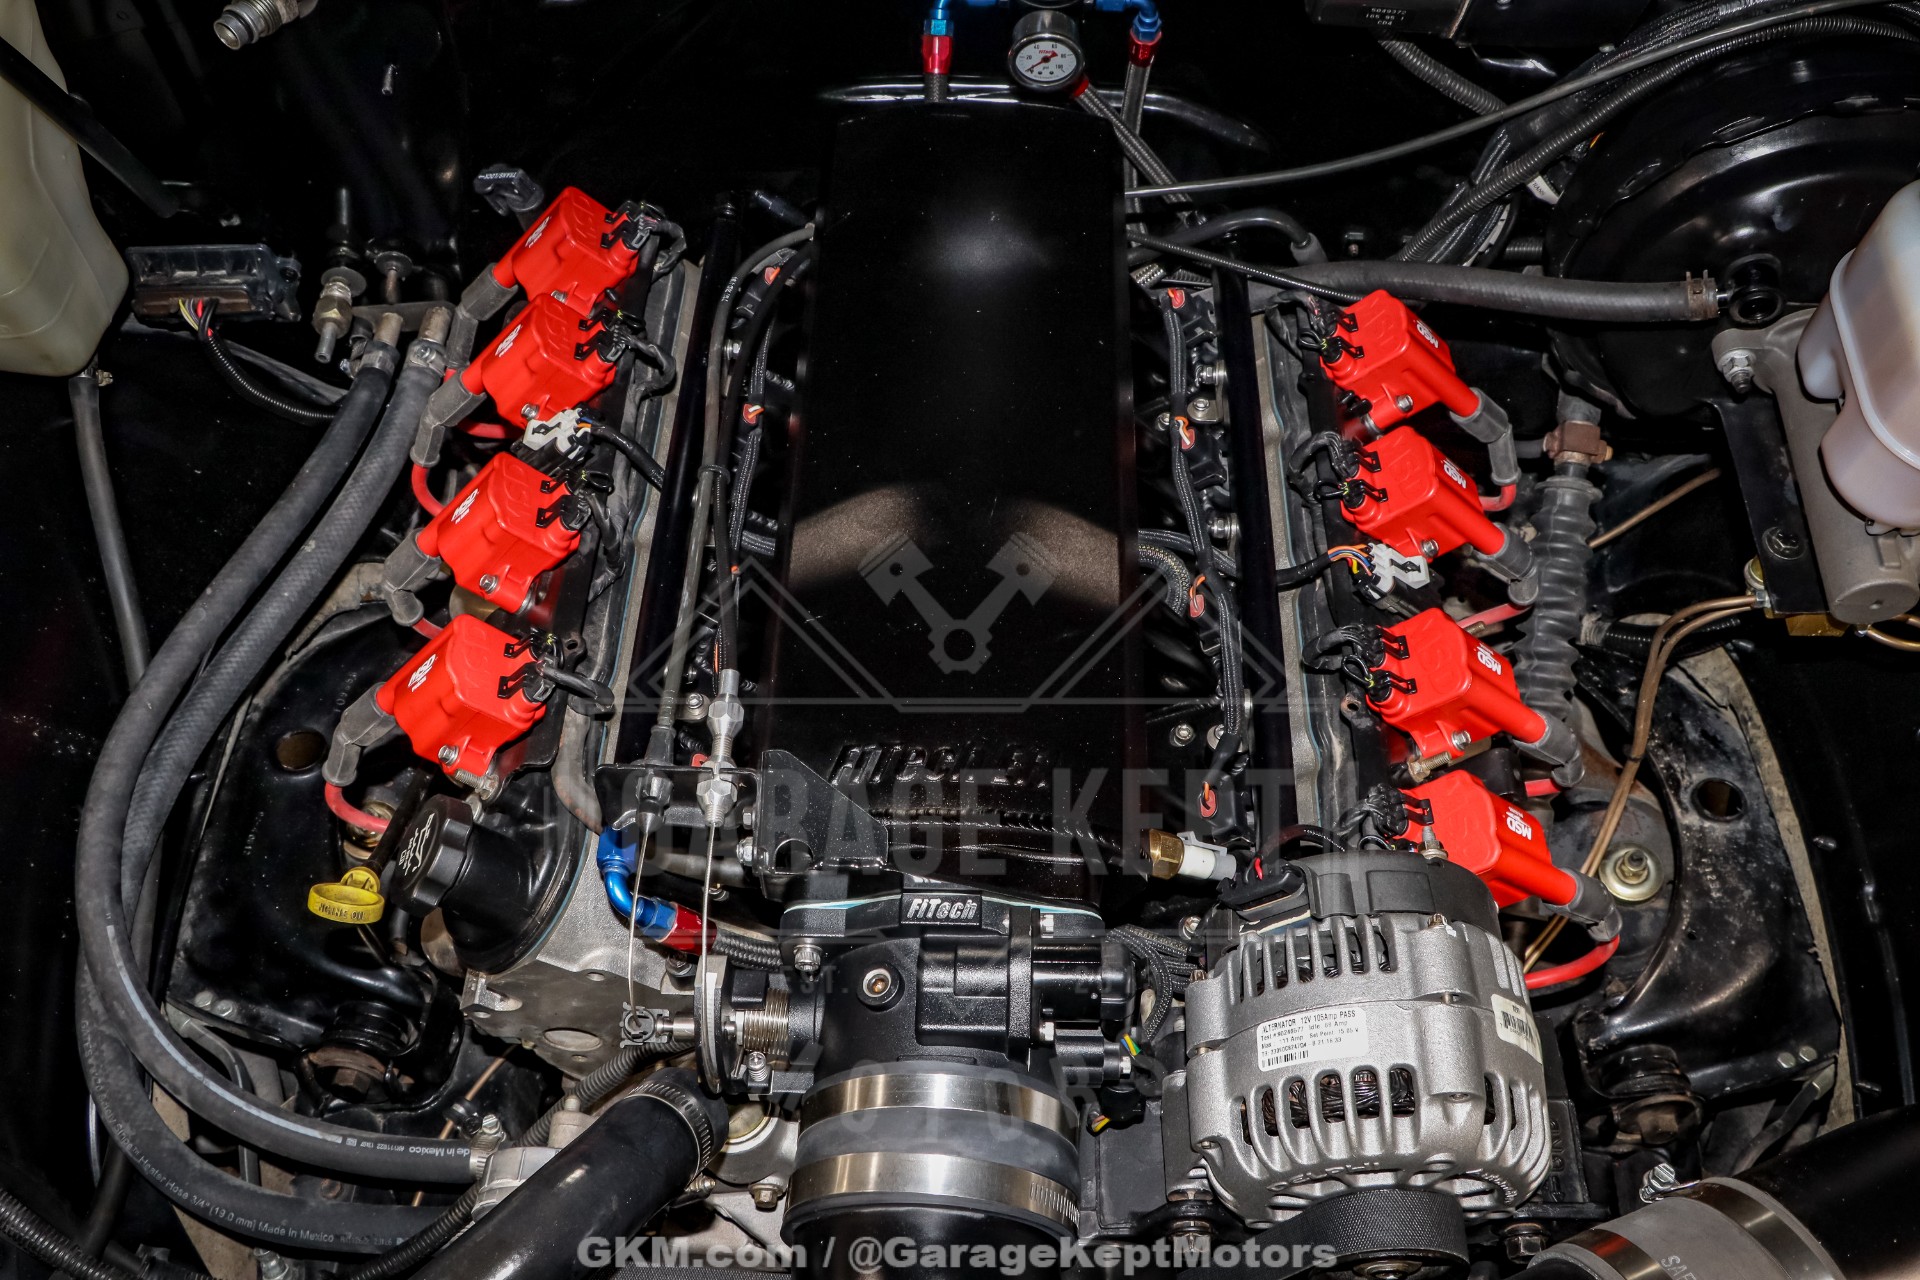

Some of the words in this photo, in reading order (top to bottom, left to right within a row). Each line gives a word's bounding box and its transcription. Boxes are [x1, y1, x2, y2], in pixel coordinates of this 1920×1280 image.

[1477, 651, 1502, 675] MSD
[1506, 816, 1532, 840] MSD
[1300, 1016, 1312, 1024] 12V
[1339, 1010, 1356, 1018] PASS
[409, 1146, 445, 1157] Mexico
[447, 1147, 455, 1156] in
[457, 1147, 471, 1157] de
[138, 1154, 167, 1183] Heater
[165, 1179, 190, 1201] Hose
[258, 1220, 286, 1238] Made
[300, 1228, 334, 1243] Mexico
